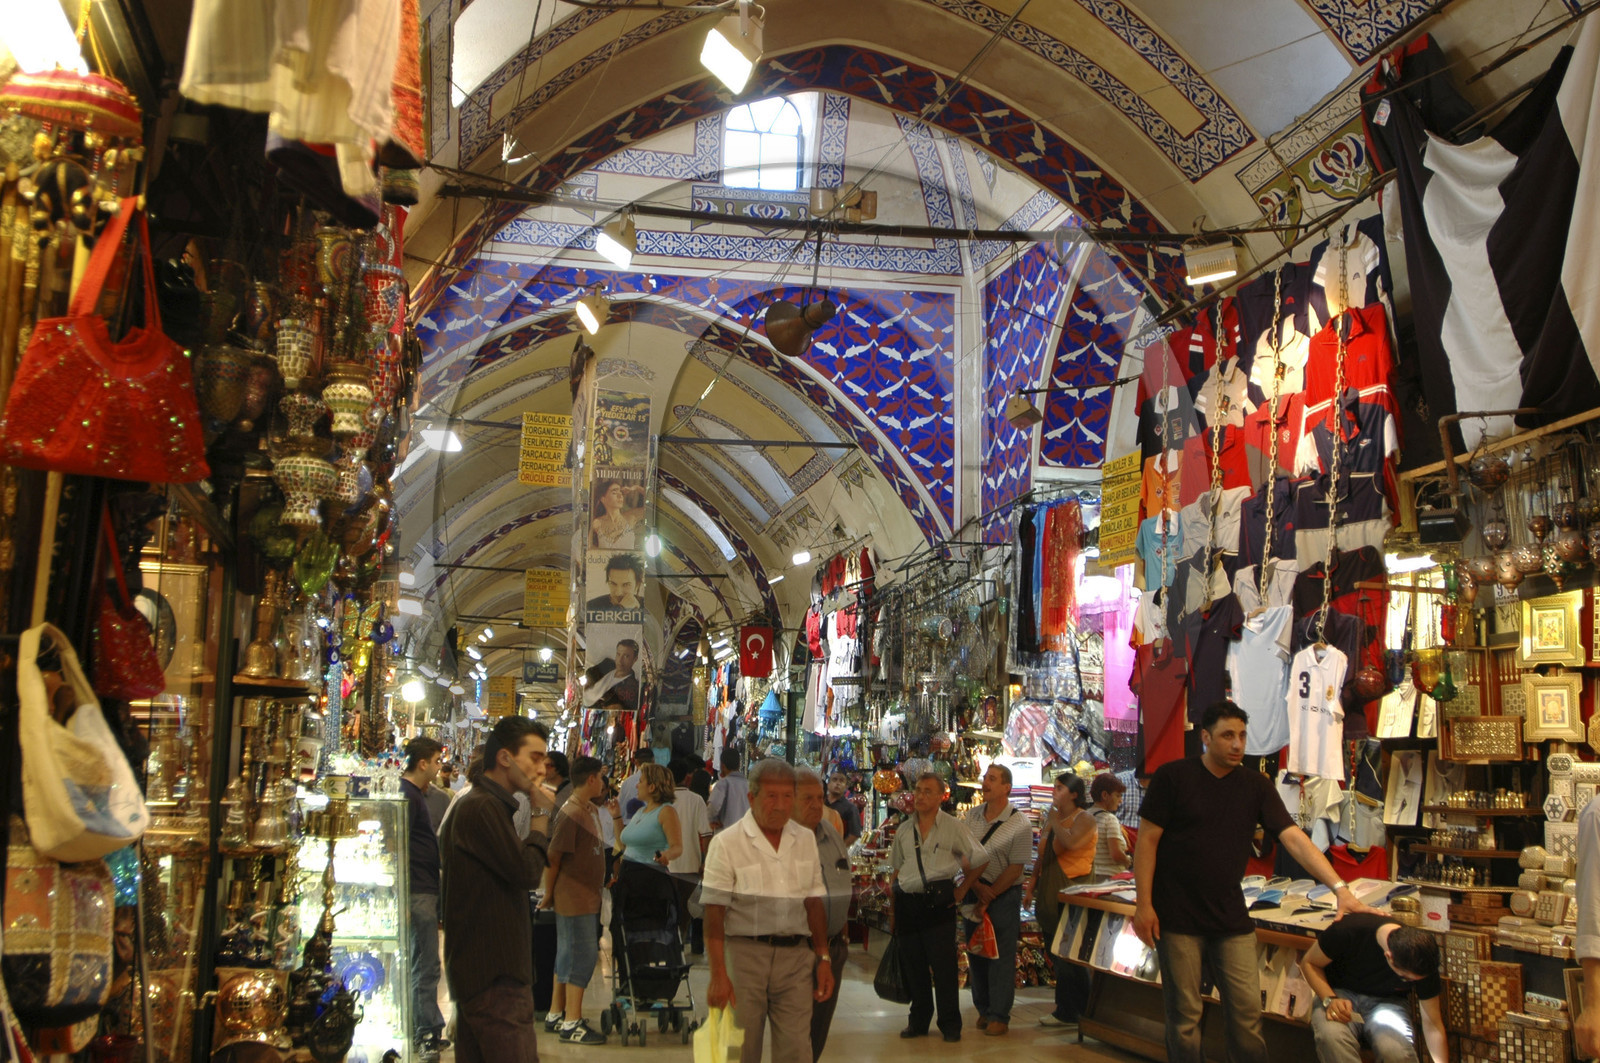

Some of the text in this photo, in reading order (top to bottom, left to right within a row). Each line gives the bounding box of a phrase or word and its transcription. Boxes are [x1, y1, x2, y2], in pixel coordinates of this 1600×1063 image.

[611, 405, 638, 414] EFSANE
[524, 426, 569, 436] YORGANCILAR
[524, 436, 563, 448] TERLİKÇİLER
[522, 449, 561, 460] PARÇACILAR
[558, 476, 572, 484] EXIT
[596, 470, 643, 480] YILDIZ TİLBE
[588, 555, 607, 564] dudu
[1299, 671, 1310, 698] 3
